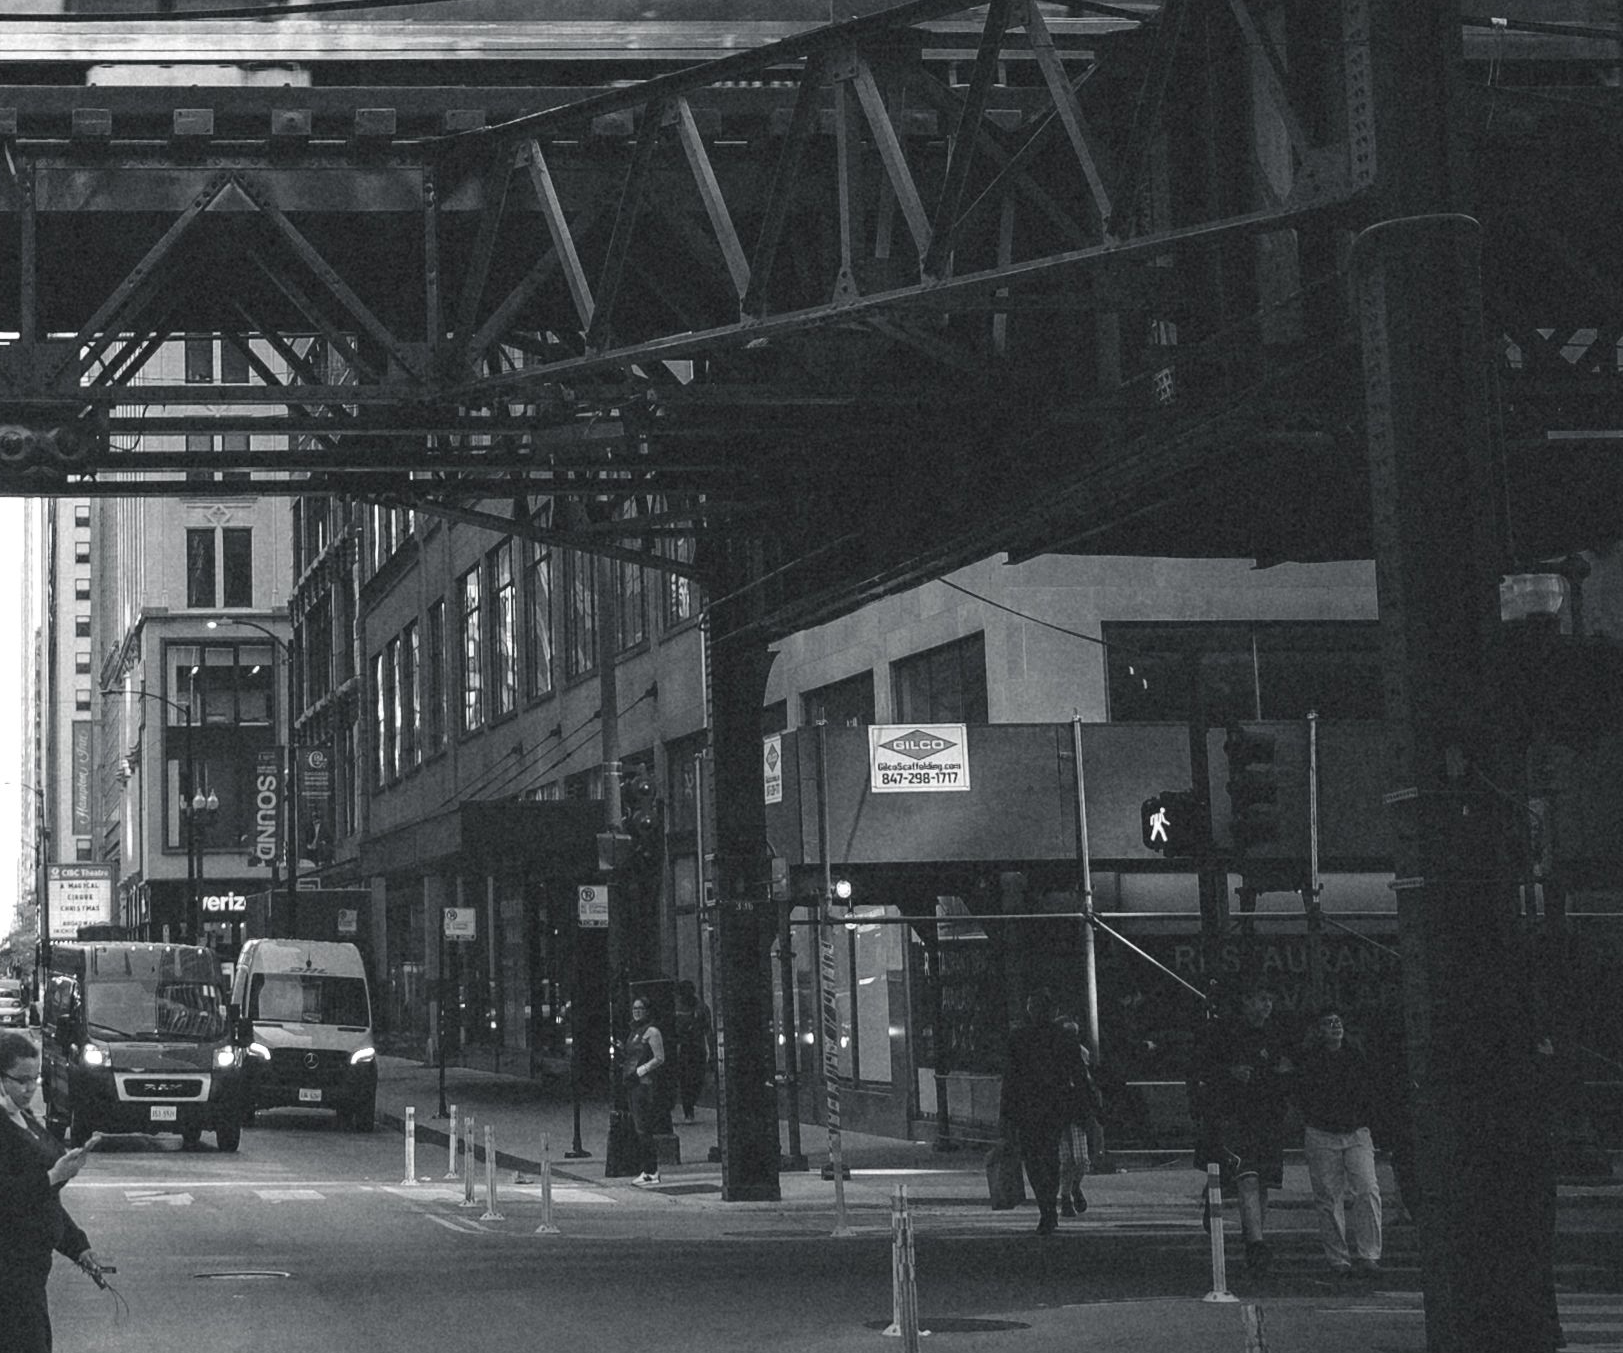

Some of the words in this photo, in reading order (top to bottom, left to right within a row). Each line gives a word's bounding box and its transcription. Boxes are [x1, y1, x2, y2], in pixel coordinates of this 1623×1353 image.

[893, 740, 944, 750] GILCO
[878, 762, 961, 772] GilcoScaffolding.com
[882, 772, 959, 785] 847-298-1717
[257, 775, 277, 860] SOUND
